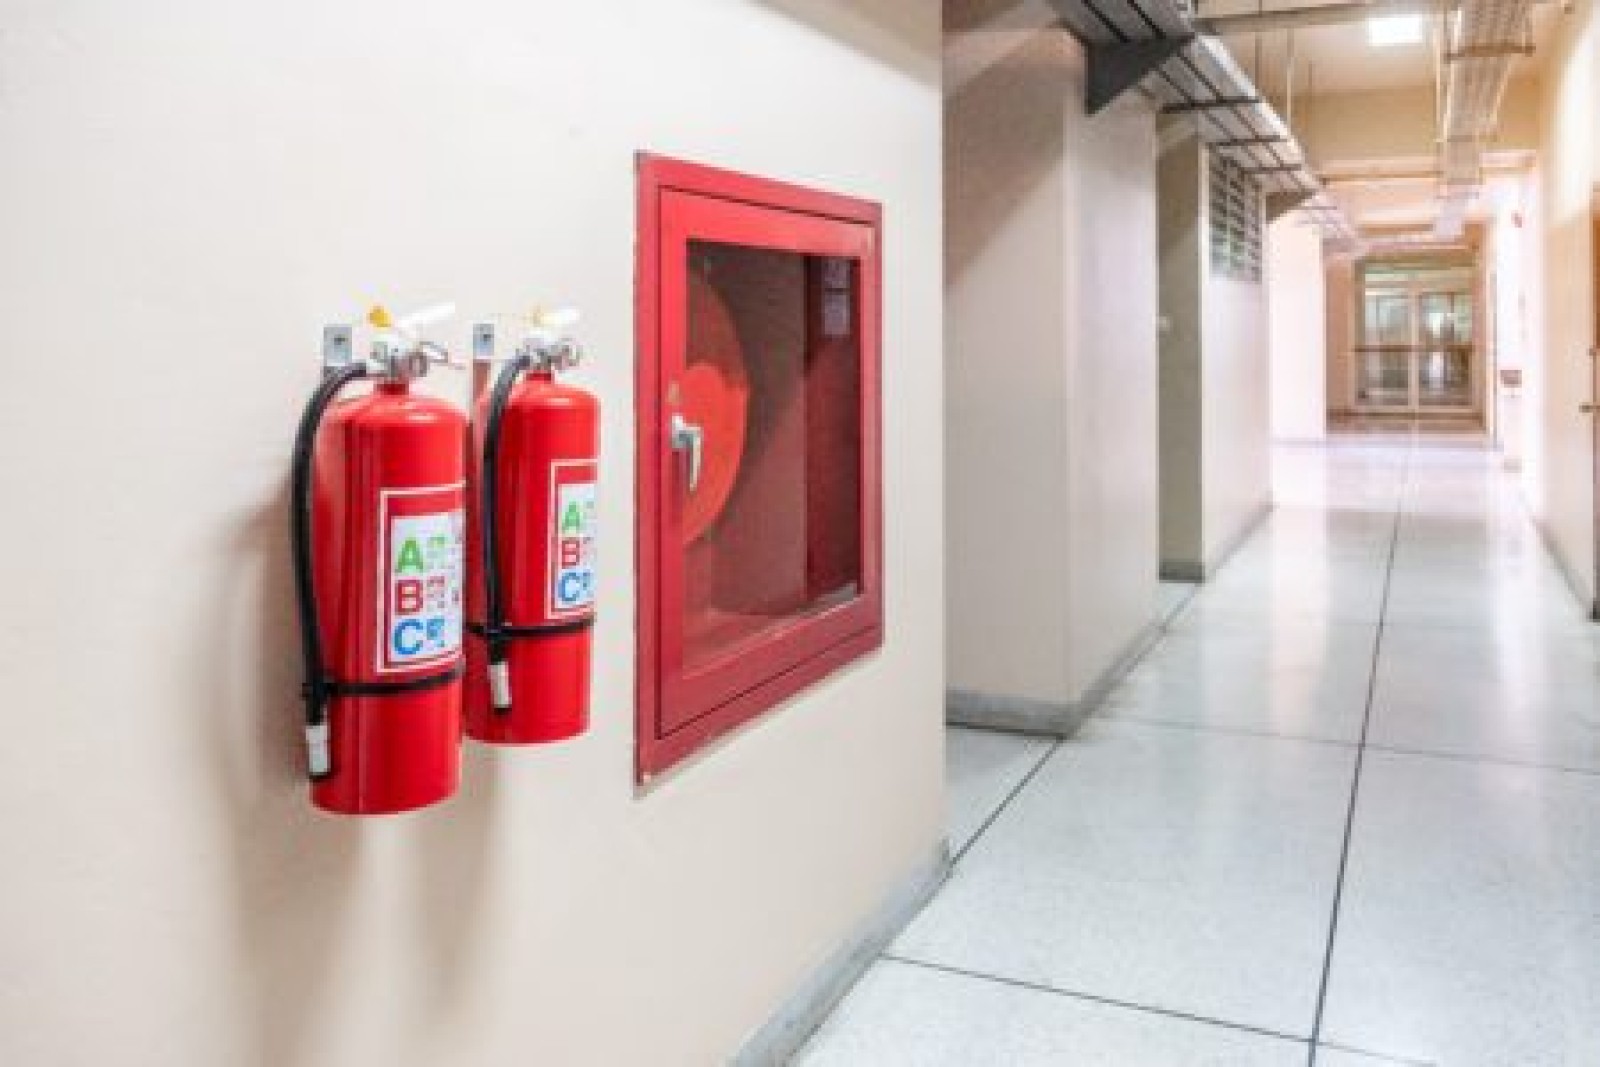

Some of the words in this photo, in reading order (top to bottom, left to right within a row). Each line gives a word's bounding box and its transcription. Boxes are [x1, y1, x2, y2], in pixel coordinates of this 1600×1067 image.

[563, 503, 581, 533] A
[395, 539, 424, 573] A
[562, 540, 581, 569] B
[395, 579, 424, 614] B
[558, 572, 581, 602] C
[394, 619, 424, 655] C
